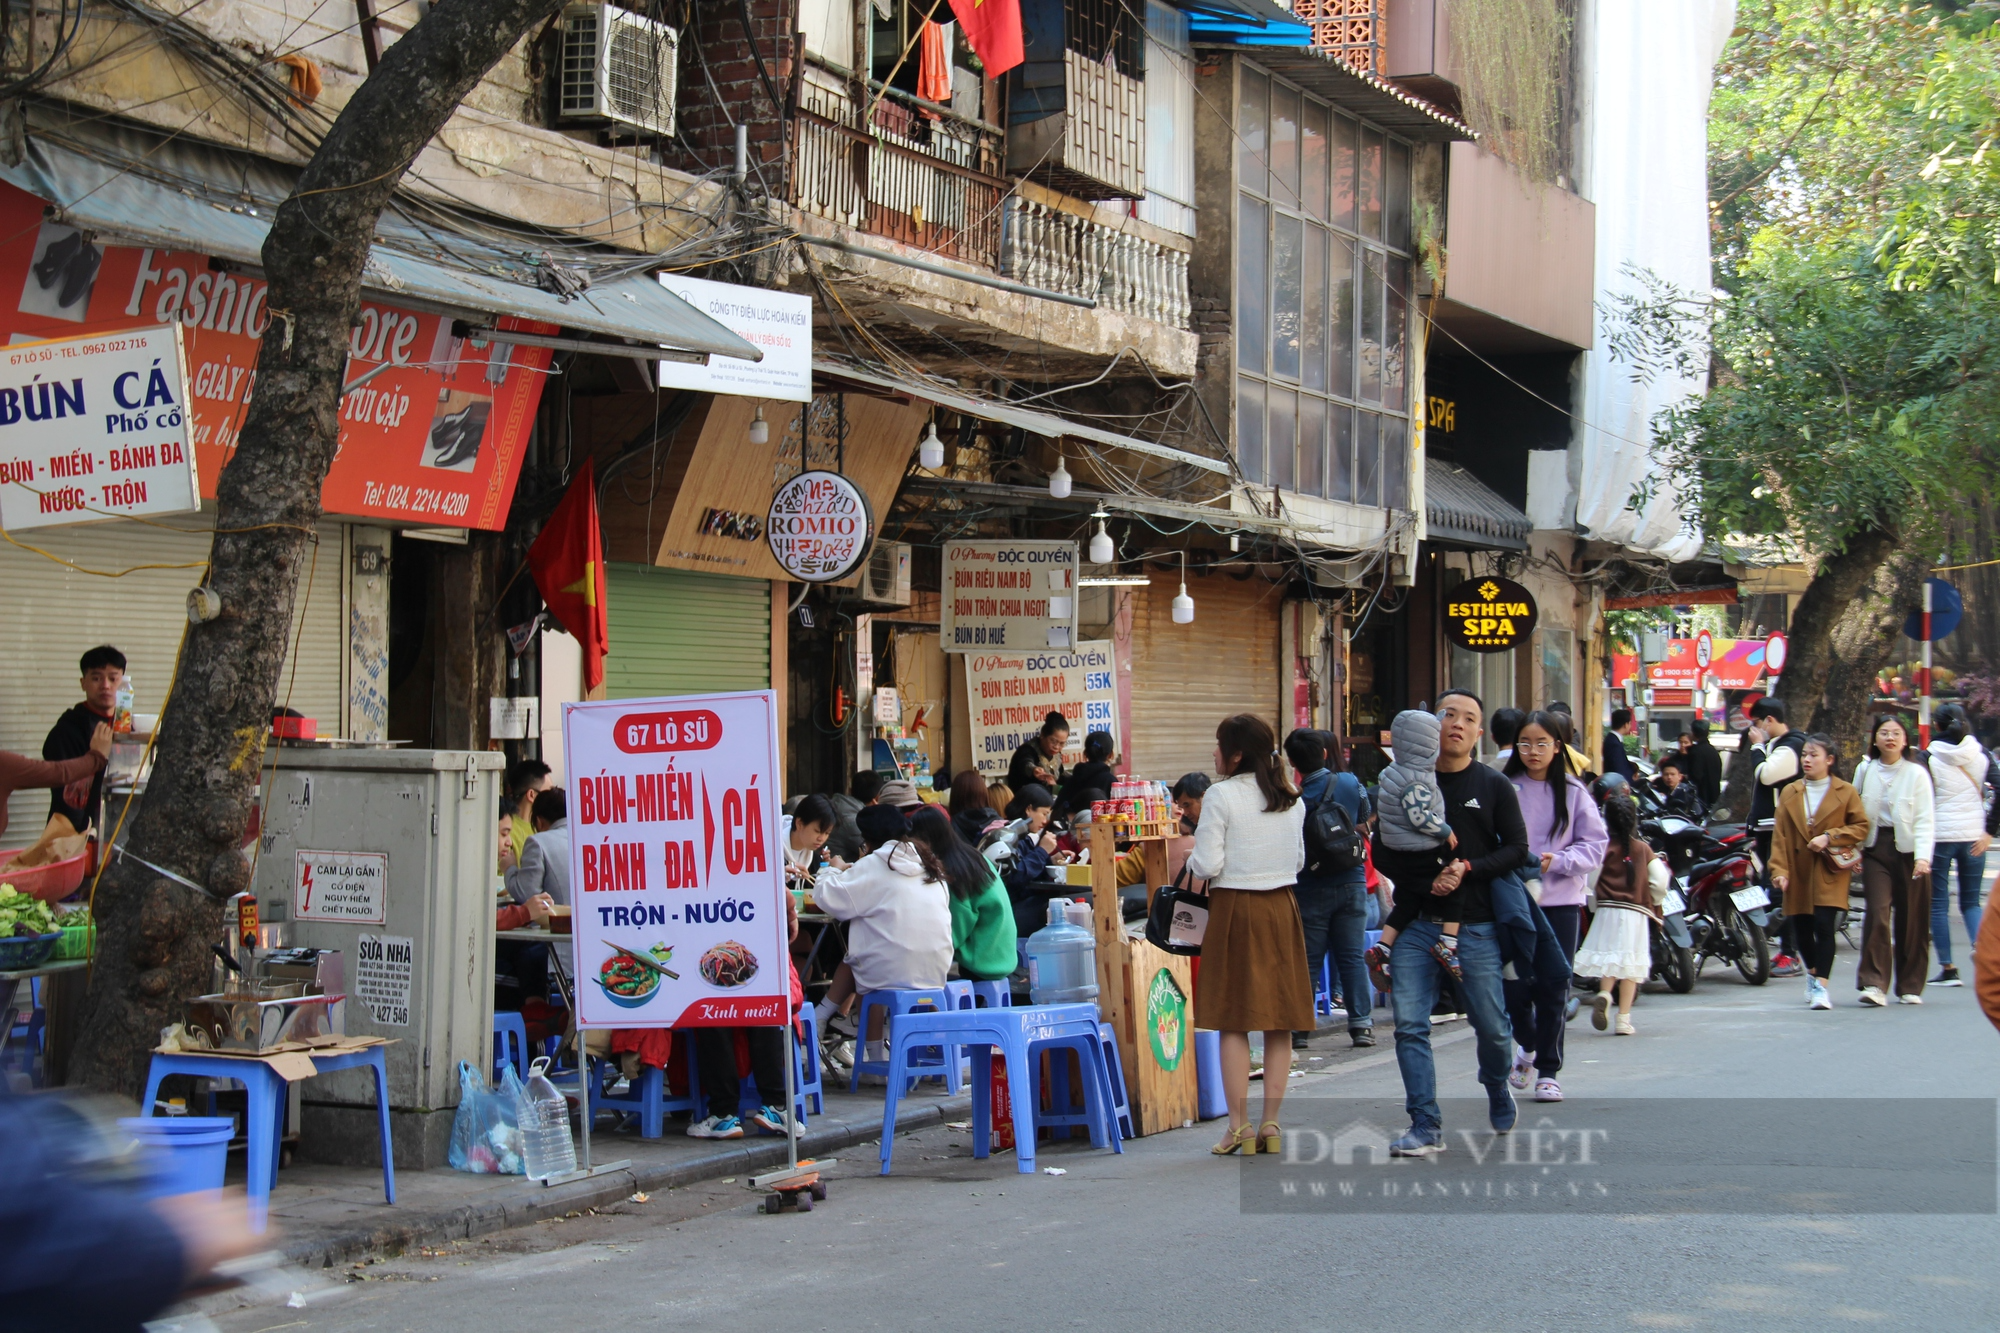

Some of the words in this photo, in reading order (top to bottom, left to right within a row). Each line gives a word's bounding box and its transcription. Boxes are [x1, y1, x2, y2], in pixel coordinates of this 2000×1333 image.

[125, 249, 268, 340] Fashio
[352, 307, 418, 366] ore
[709, 299, 730, 315] CÔNG
[731, 304, 740, 318] TY
[740, 304, 756, 321] ĐIỆN
[771, 308, 790, 324] HOÀN
[790, 309, 806, 326] KIẾM
[10, 355, 22, 365] 67
[24, 351, 37, 363] LÒ
[39, 348, 53, 361] SŨ
[60, 347, 80, 358] TEL.
[82, 343, 107, 355] 0962
[108, 341, 127, 352] 022
[128, 338, 147, 349] 716
[762, 332, 776, 348] ĐIỆN
[776, 333, 785, 347] SỐ
[785, 337, 791, 348] 02
[0, 374, 87, 426] BÚN
[112, 358, 175, 410] CÁ
[105, 410, 149, 434] Phố
[155, 405, 182, 428] cổ
[375, 384, 410, 434] CẶP
[1429, 396, 1455, 433] SPA
[0, 457, 34, 485] BÚN
[50, 447, 94, 479] MIẾN
[109, 444, 156, 472] BÁNH
[160, 442, 184, 465] ĐA
[39, 484, 86, 514] NƯỚC
[102, 478, 147, 510] TRỘN
[363, 481, 385, 507] Tel:
[386, 484, 410, 510] 024.
[411, 487, 442, 513] 2214
[441, 491, 470, 517] 4200
[770, 516, 855, 535] ROMIO
[362, 551, 377, 571] 69
[962, 547, 996, 562] Phương
[997, 548, 1025, 566] ĐỘC
[1028, 546, 1072, 563] QUYỀN
[955, 568, 973, 588] BÚN
[976, 568, 995, 588] RIÊU
[997, 571, 1017, 588] NAM
[1019, 568, 1032, 592] BỘ
[955, 596, 973, 616] BÚN
[975, 596, 998, 620] TRỘN
[1000, 600, 1021, 617] CHUA
[1024, 600, 1046, 620] NGỌT
[1448, 603, 1530, 617] ESTHEVA
[955, 623, 973, 644] BÚN
[975, 624, 987, 644] BÒ
[989, 622, 1007, 645] HUẾ
[1463, 618, 1517, 636] SPA
[986, 655, 1024, 671] Phương
[1026, 653, 1056, 673] ĐỘC
[1059, 647, 1106, 669] QUYỀN
[981, 677, 1001, 698] BÚN
[1004, 676, 1025, 696] RIÊU
[1028, 677, 1049, 695] NAM
[1052, 672, 1066, 697] BỘ
[1086, 672, 1112, 690] 55K
[983, 705, 1003, 726] BÚN
[1005, 703, 1031, 727] TRỘN
[1059, 702, 1083, 722] NGỌT
[1086, 702, 1111, 720] 55K
[627, 724, 649, 747] 67
[655, 717, 678, 745] LÒ
[683, 716, 708, 743] SŨ
[985, 731, 1005, 753] BÚN
[579, 756, 694, 825] BÚN-MIẾN
[722, 774, 767, 876] CÁ
[582, 836, 647, 892] BÁNH
[664, 840, 698, 889] ĐA
[322, 904, 343, 914] CHẾT
[346, 904, 373, 915] NGƯỜI
[325, 894, 348, 902] NGUY
[598, 901, 665, 930] TRỘN
[685, 897, 755, 924] NƯỚC
[387, 941, 411, 963] NHÀ
[377, 1005, 391, 1022] 427
[393, 1007, 408, 1024] 546
